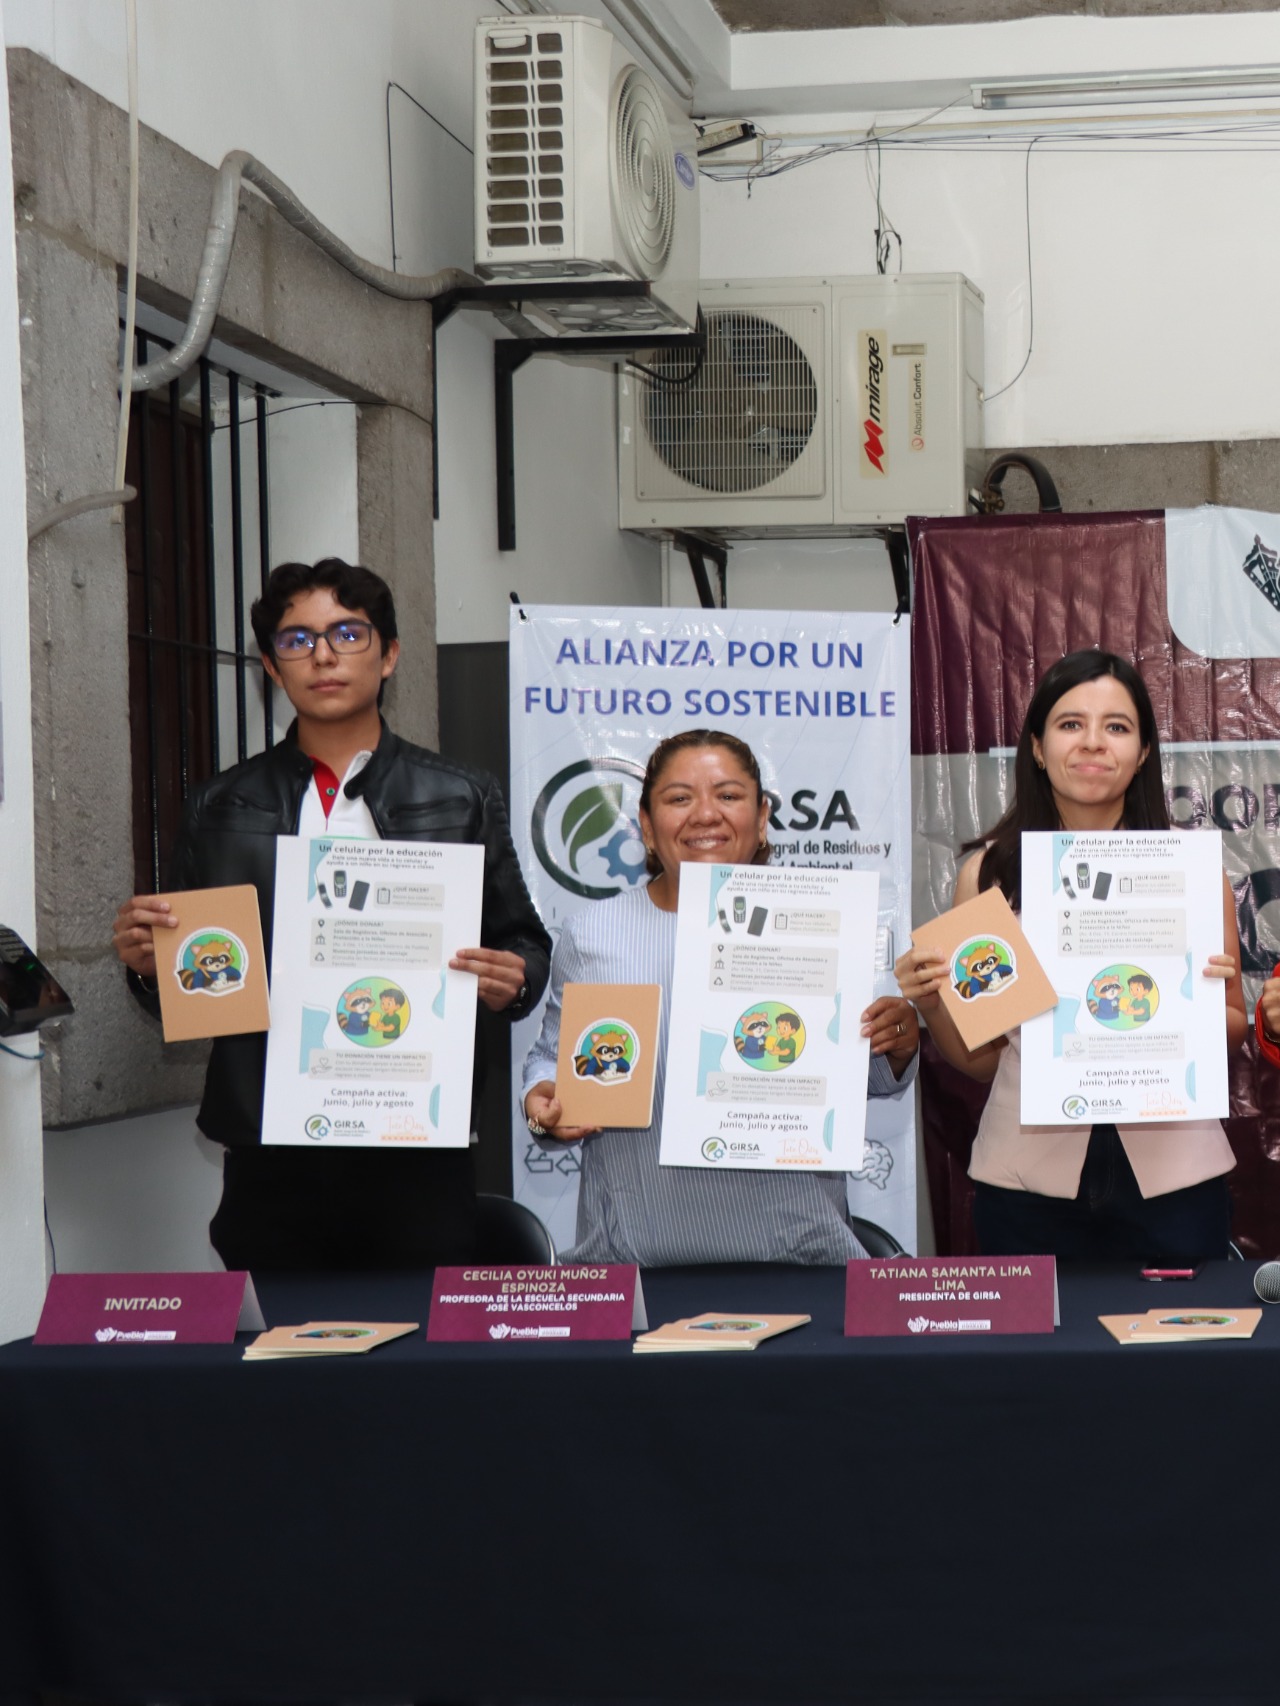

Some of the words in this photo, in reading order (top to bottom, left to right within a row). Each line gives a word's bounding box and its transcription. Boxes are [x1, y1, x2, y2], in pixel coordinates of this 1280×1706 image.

[866, 337, 884, 423] mirage
[556, 638, 715, 668] ALIANZA
[728, 641, 799, 669] POR
[812, 642, 863, 669] UN
[525, 687, 672, 716] FUTURO
[684, 689, 896, 718] SOSTENIBLE
[335, 846, 365, 854] celular
[368, 847, 383, 856] por
[397, 848, 442, 857] educación
[804, 840, 819, 854] de
[824, 840, 880, 855] Residuos
[884, 843, 891, 857] y
[735, 872, 764, 880] celular
[767, 874, 781, 882] por
[784, 873, 792, 881] la
[795, 874, 838, 883] educación
[1091, 1099, 1122, 1107] GIRSA
[727, 1111, 770, 1120] Campaña
[772, 1113, 802, 1121] activa:
[335, 1120, 365, 1128] GIRSA
[720, 1121, 745, 1129] Junio,
[748, 1121, 768, 1130] julio
[778, 1123, 808, 1131] agosto
[730, 1143, 760, 1151] GIRSA
[463, 1270, 513, 1281] CECILIA
[517, 1270, 557, 1280] OYUKI
[561, 1268, 607, 1280] MUÑOZ
[870, 1268, 927, 1279] TATIANA
[932, 1267, 996, 1278] SAMANTA
[1000, 1266, 1031, 1277] LIMA
[502, 1282, 566, 1293] ESPINOZA
[935, 1280, 966, 1291] LIMA
[440, 1295, 494, 1303] PROFESORA
[497, 1295, 508, 1303] DE
[511, 1295, 522, 1303] LA
[525, 1294, 565, 1302] ESCUELA
[568, 1293, 625, 1302] SECUNDARIA
[899, 1292, 956, 1301] PRESIDENTA
[959, 1292, 970, 1300] DE
[973, 1291, 1001, 1300] GIRSA
[104, 1297, 181, 1310] INVITADO
[486, 1302, 508, 1312] JOSÉ
[511, 1302, 577, 1311] VASCONCELOS
[930, 1320, 958, 1329] Puebla
[117, 1331, 144, 1340] Puebla
[511, 1327, 538, 1336] Puebla
